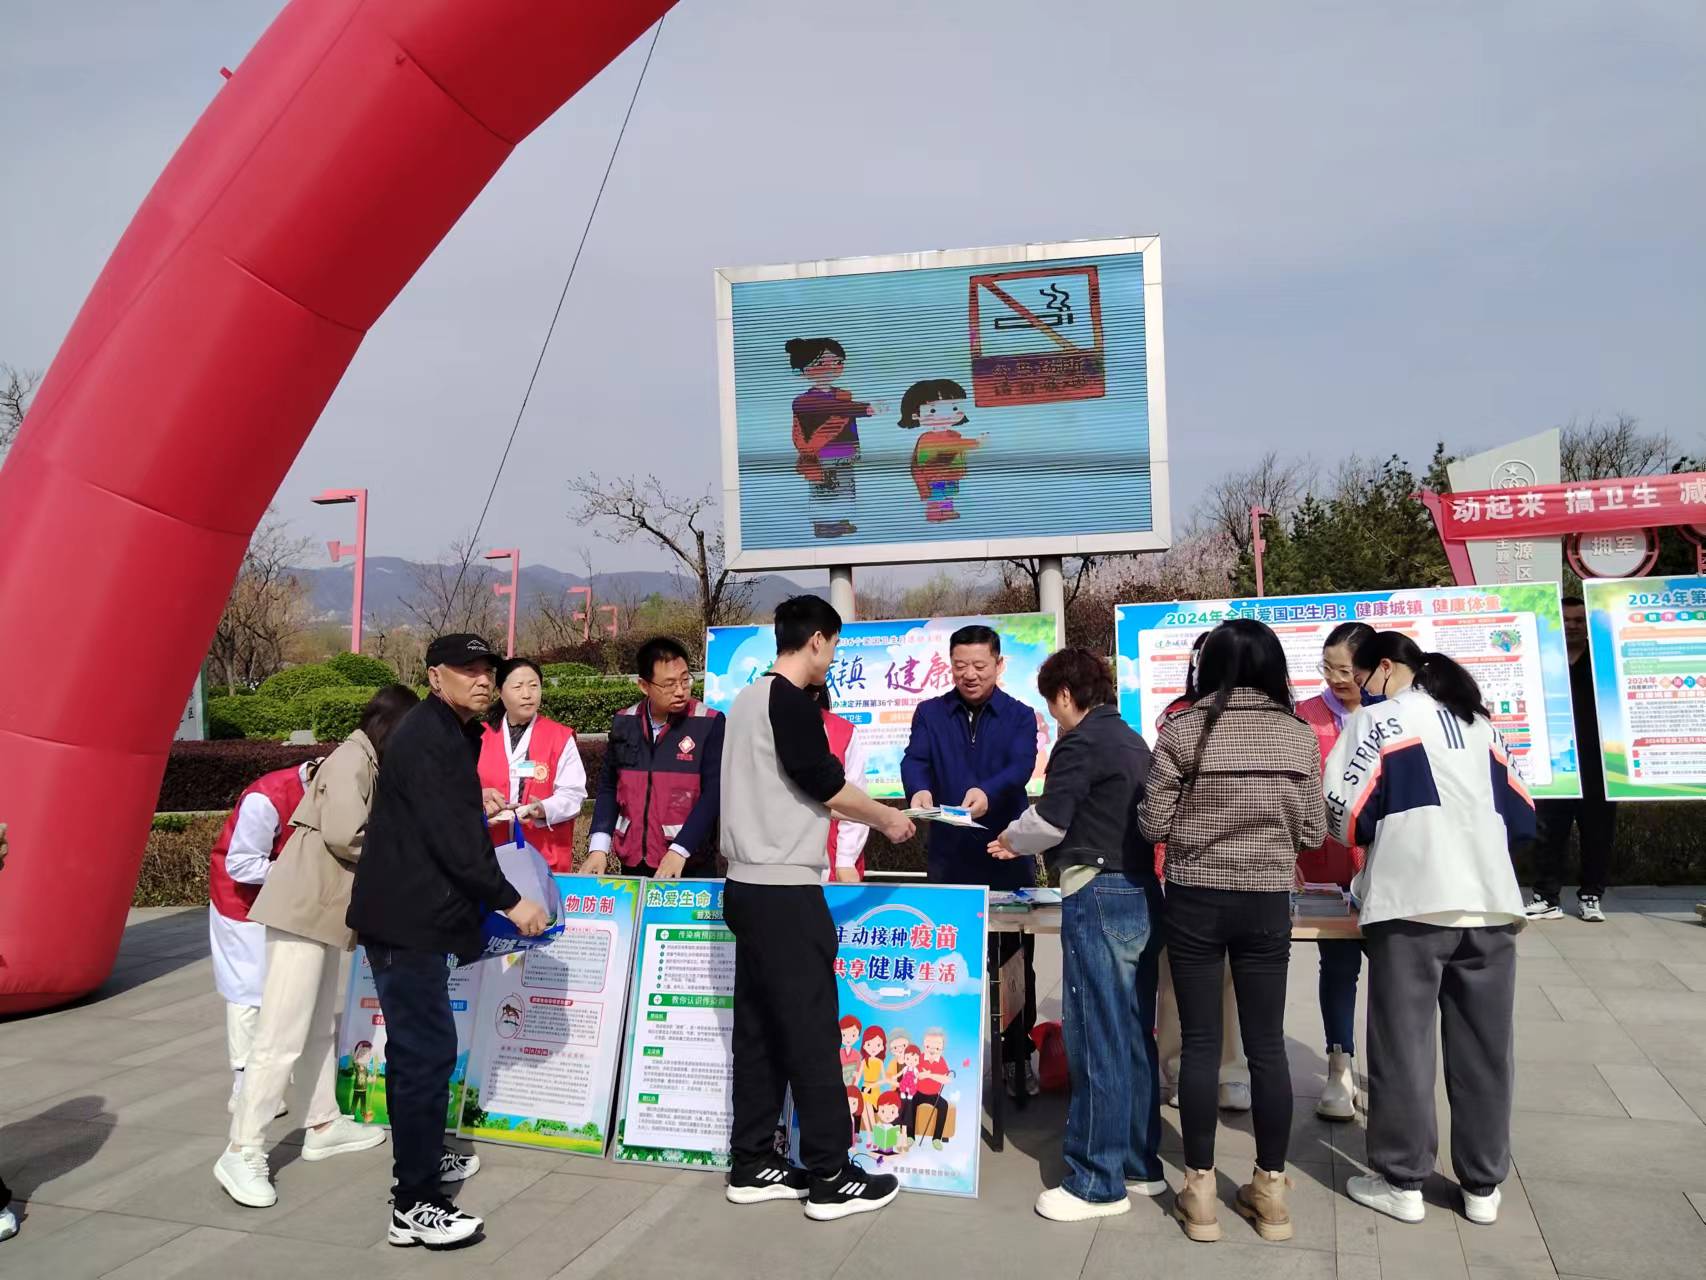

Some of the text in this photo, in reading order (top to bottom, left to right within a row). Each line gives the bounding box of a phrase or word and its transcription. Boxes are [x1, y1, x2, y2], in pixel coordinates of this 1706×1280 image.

[1453, 491, 1546, 523] 动起来
[1564, 482, 1661, 514] 搞卫生
[1591, 535, 1636, 556] 拥军
[1432, 595, 1501, 613] 健康体重
[1343, 717, 1403, 785] STRIPES
[566, 895, 615, 914] 物防制
[647, 890, 711, 907] 热爱生命
[836, 925, 958, 950] 主动接种疫苗
[832, 955, 957, 983] 共享健康生活
